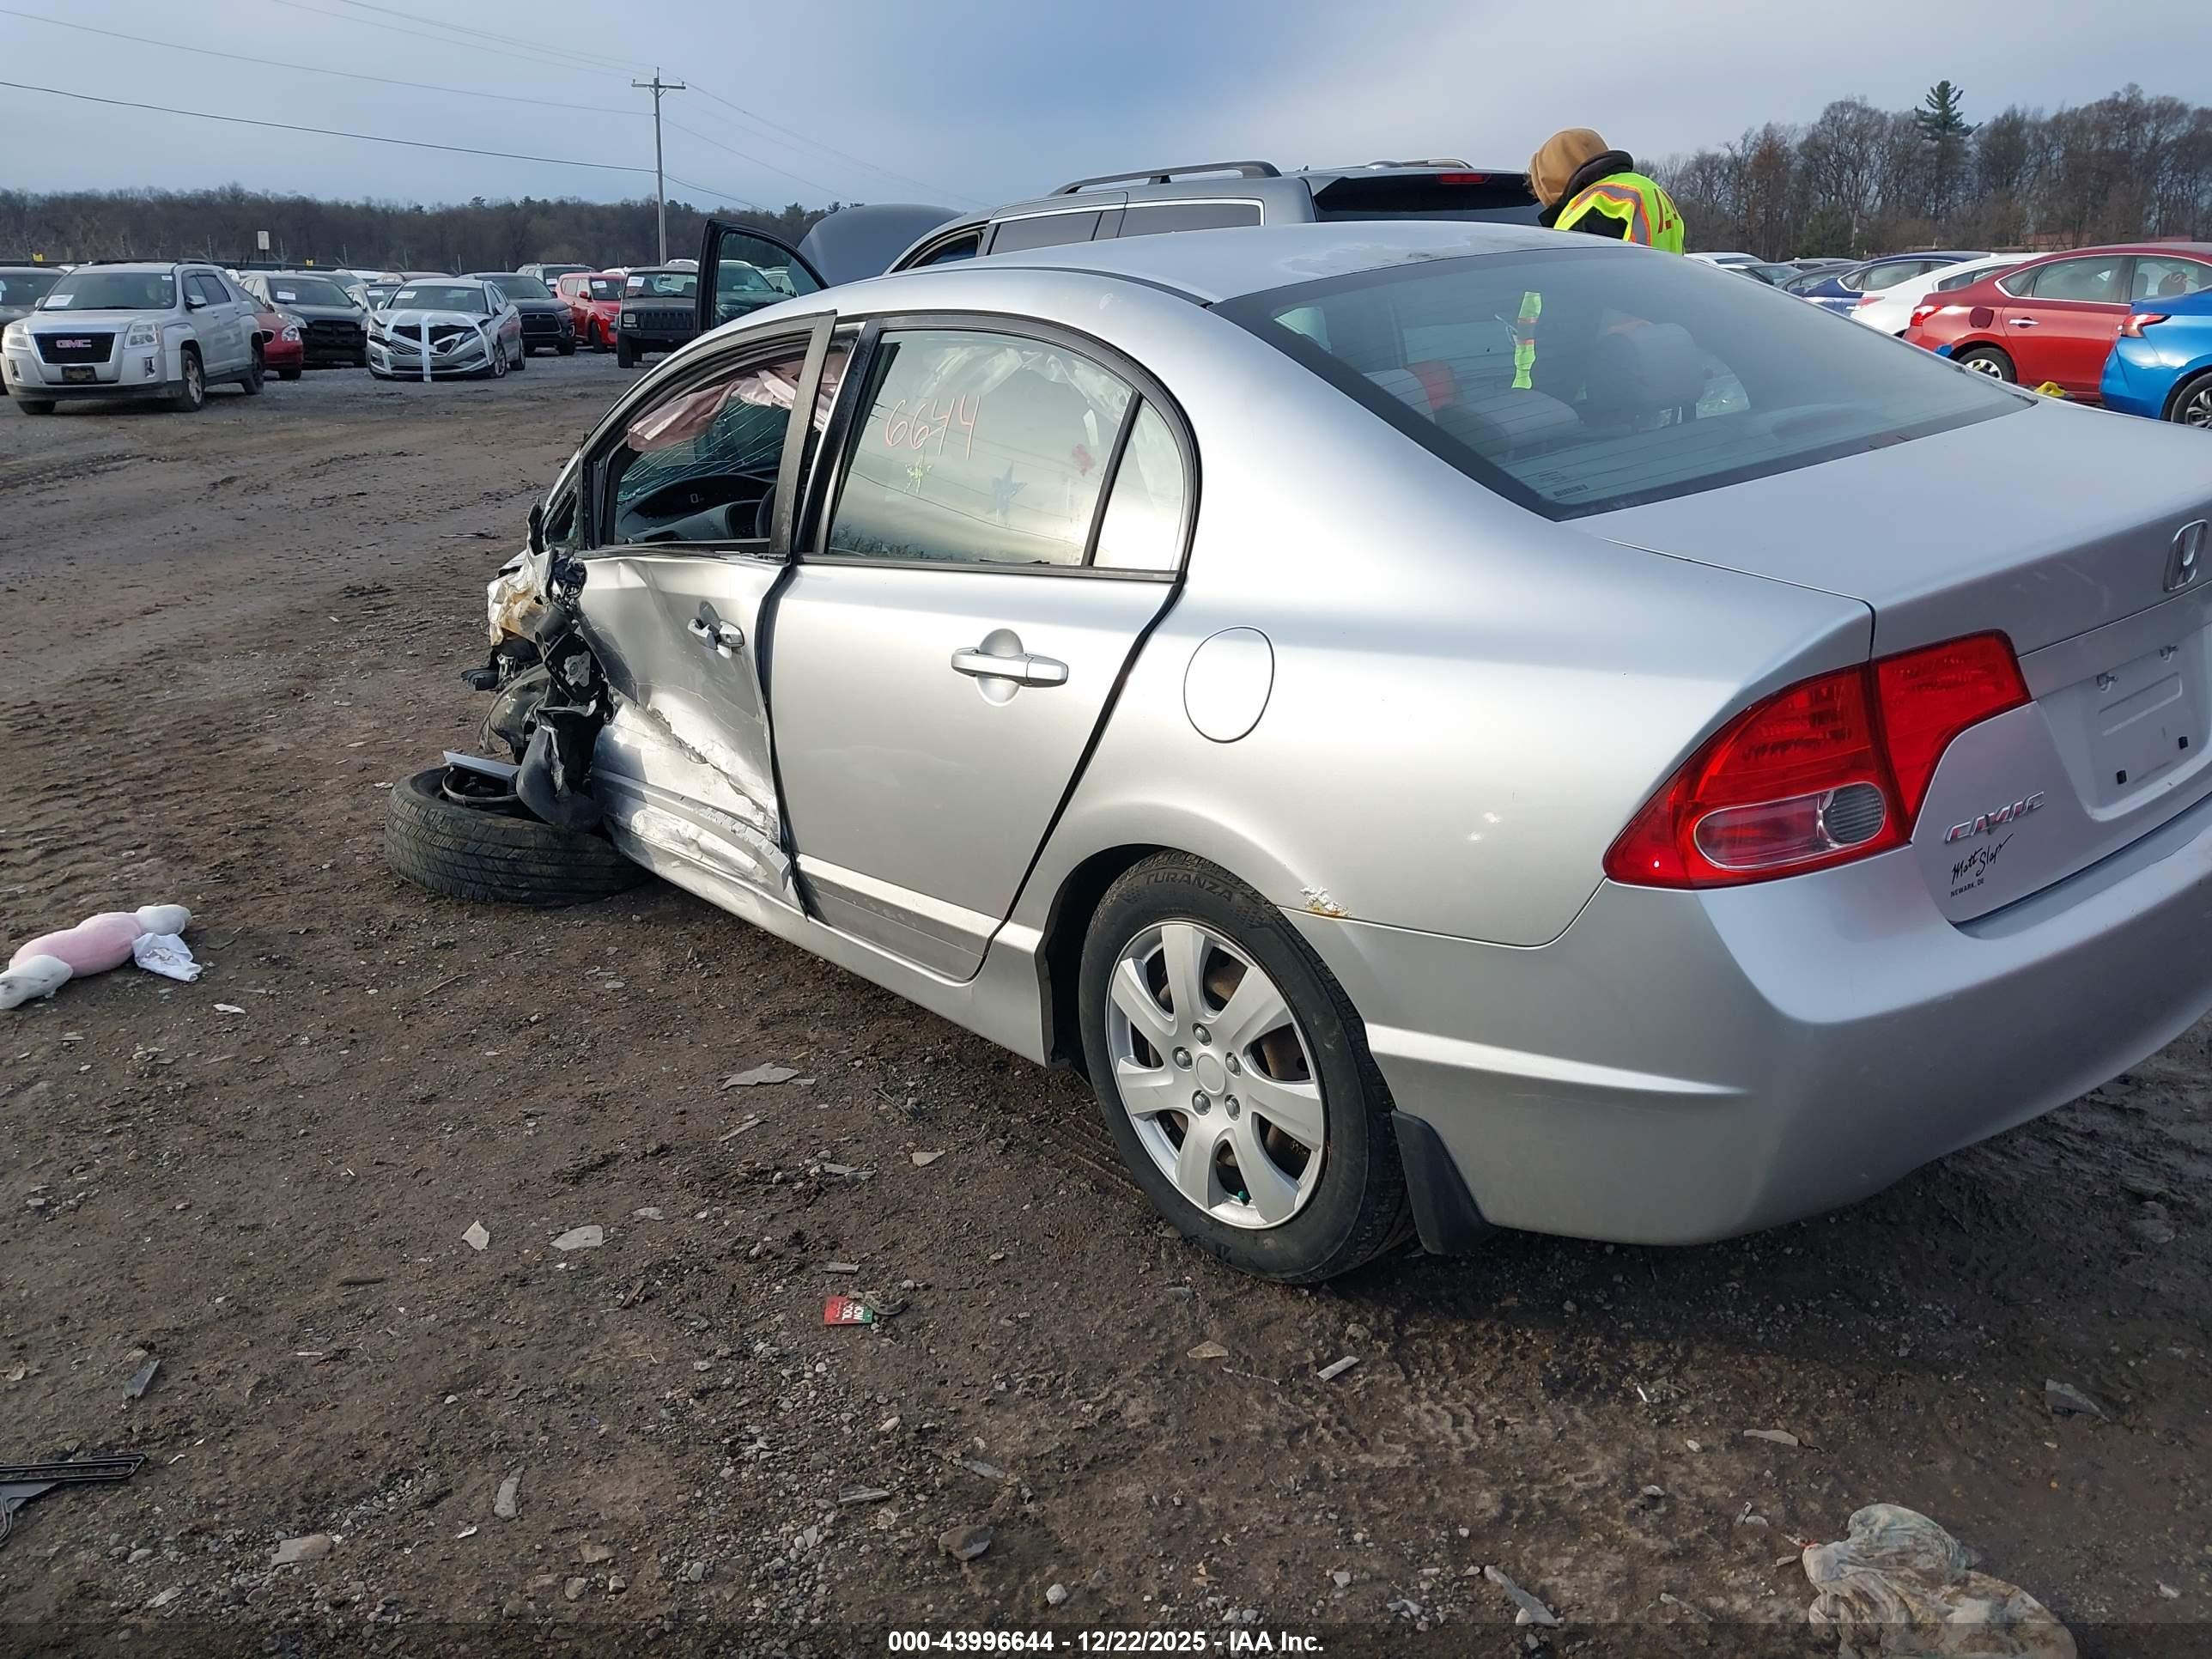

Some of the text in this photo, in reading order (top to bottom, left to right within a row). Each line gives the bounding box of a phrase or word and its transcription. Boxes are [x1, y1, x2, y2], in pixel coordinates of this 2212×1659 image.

[56, 339, 92, 349] GMC
[885, 392, 981, 460] 6644
[1945, 791, 2045, 843] CIVIC
[1146, 871, 1233, 902] TURANZA
